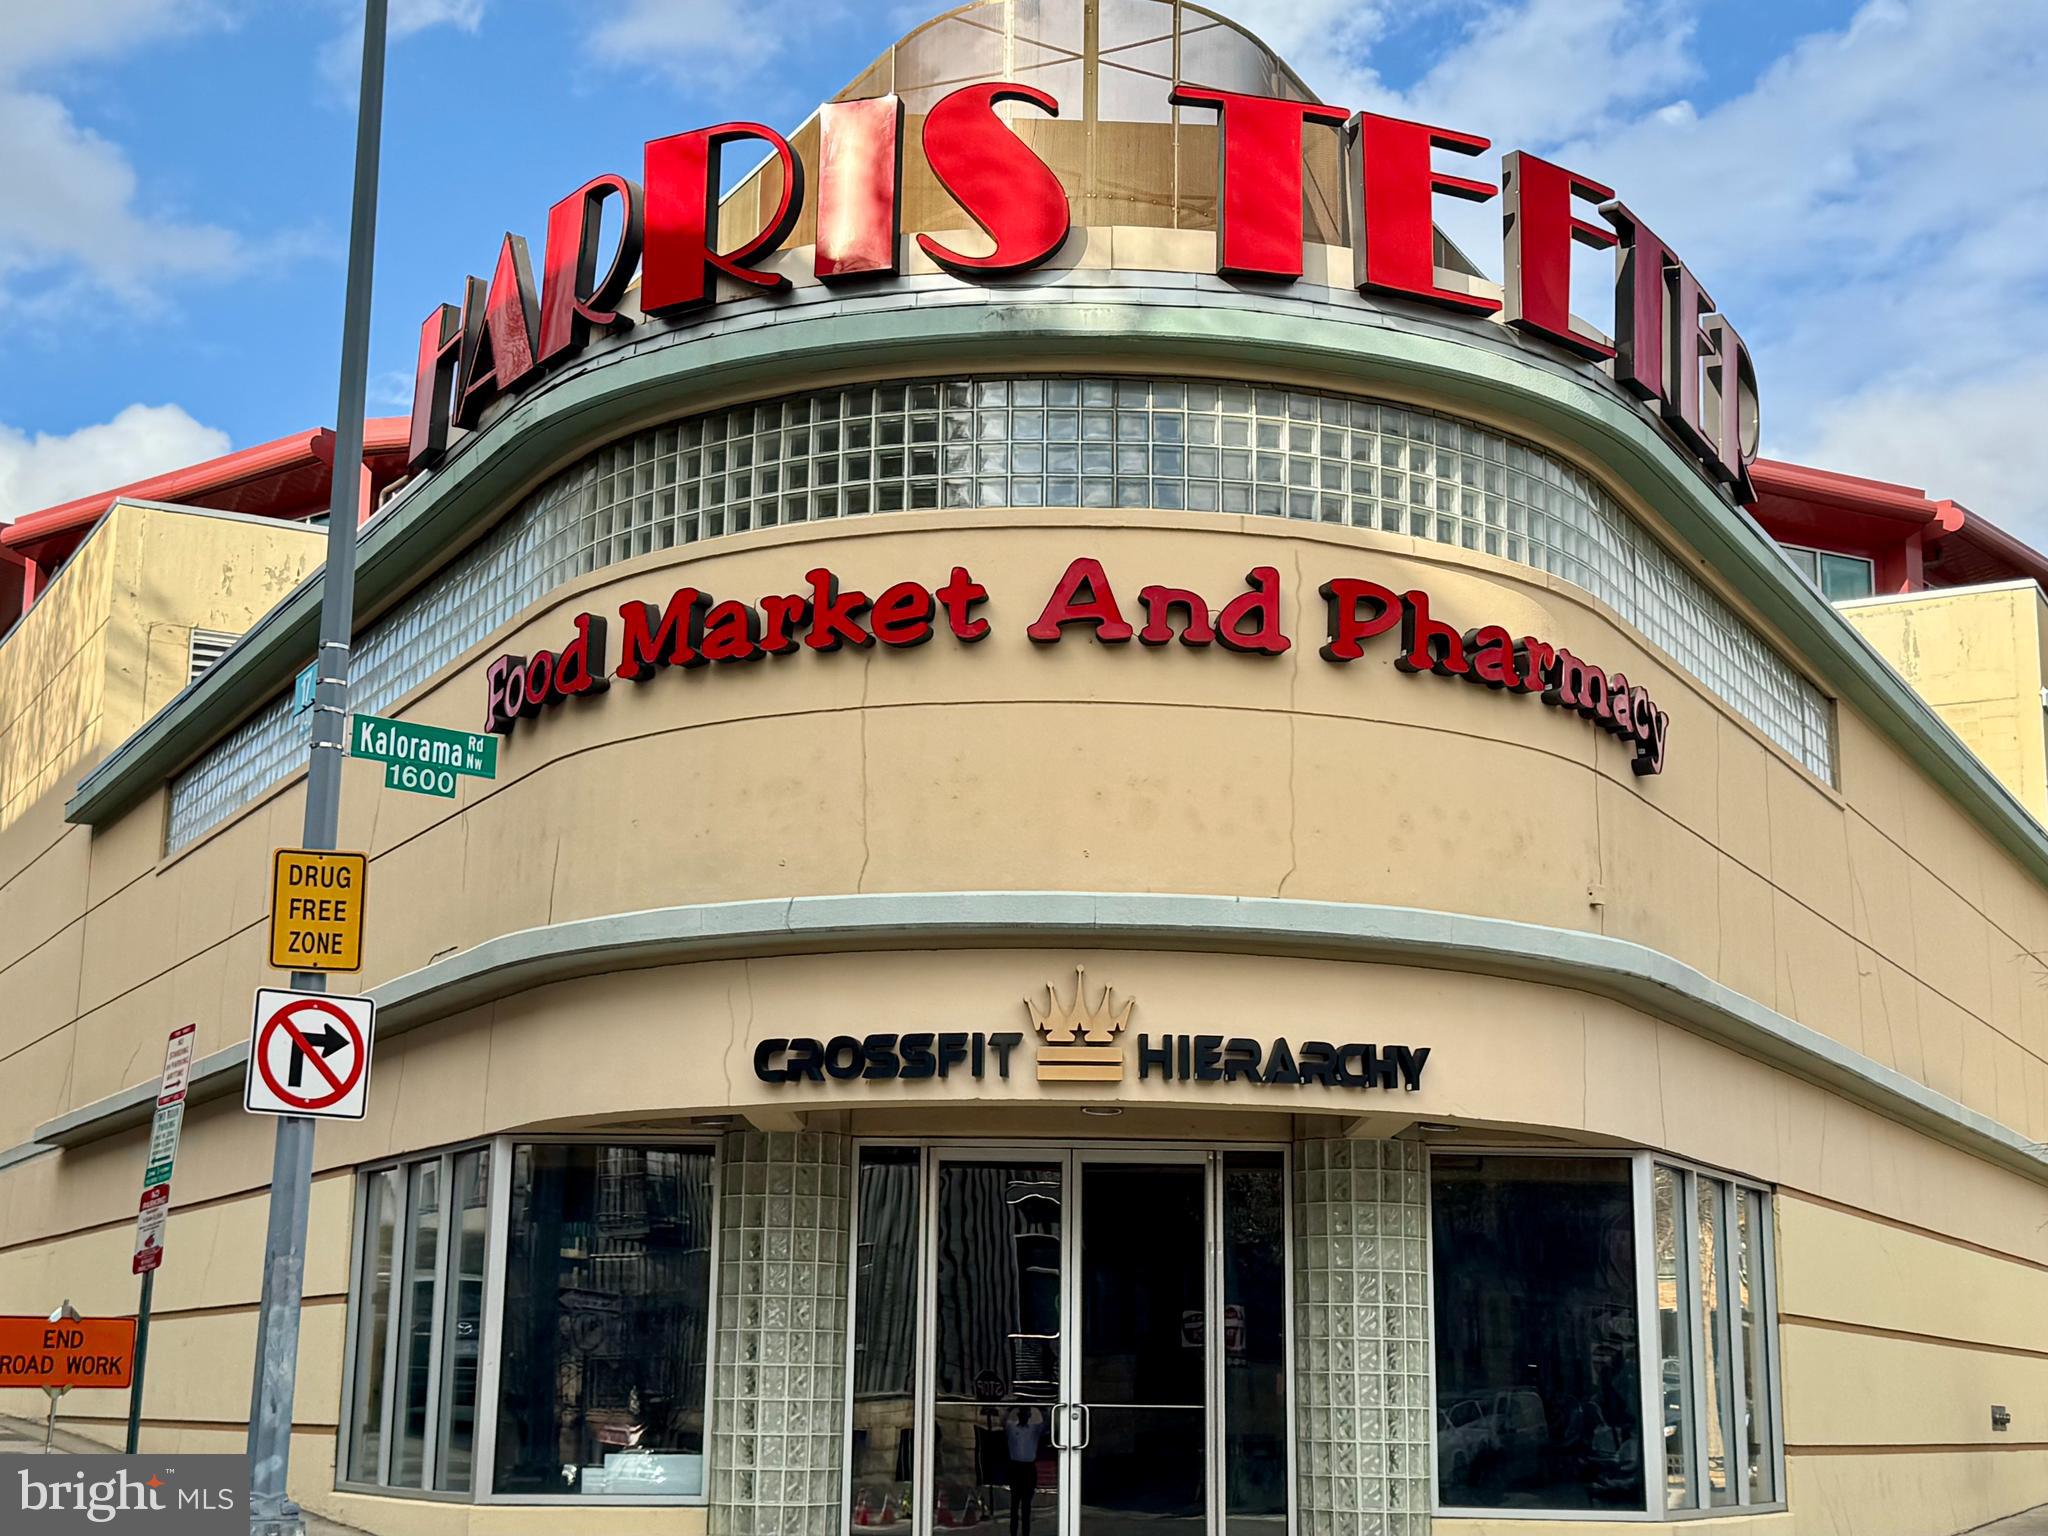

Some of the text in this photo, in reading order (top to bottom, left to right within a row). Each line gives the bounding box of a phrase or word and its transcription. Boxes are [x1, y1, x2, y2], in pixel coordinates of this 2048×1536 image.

[408, 82, 1761, 504] HARRIS TEETER
[485, 557, 1670, 776] Food Market And Pharmacy
[360, 721, 463, 768] Kalorama
[468, 735, 484, 753] Rd
[389, 764, 454, 794] 1600
[289, 864, 351, 889] DRUG
[289, 898, 347, 922] FREE
[288, 930, 343, 955] ZONE
[753, 1031, 1432, 1092] CROSSFIT HIERARCHY
[43, 1329, 84, 1350] END
[0, 1355, 122, 1375] ROAD WORK
